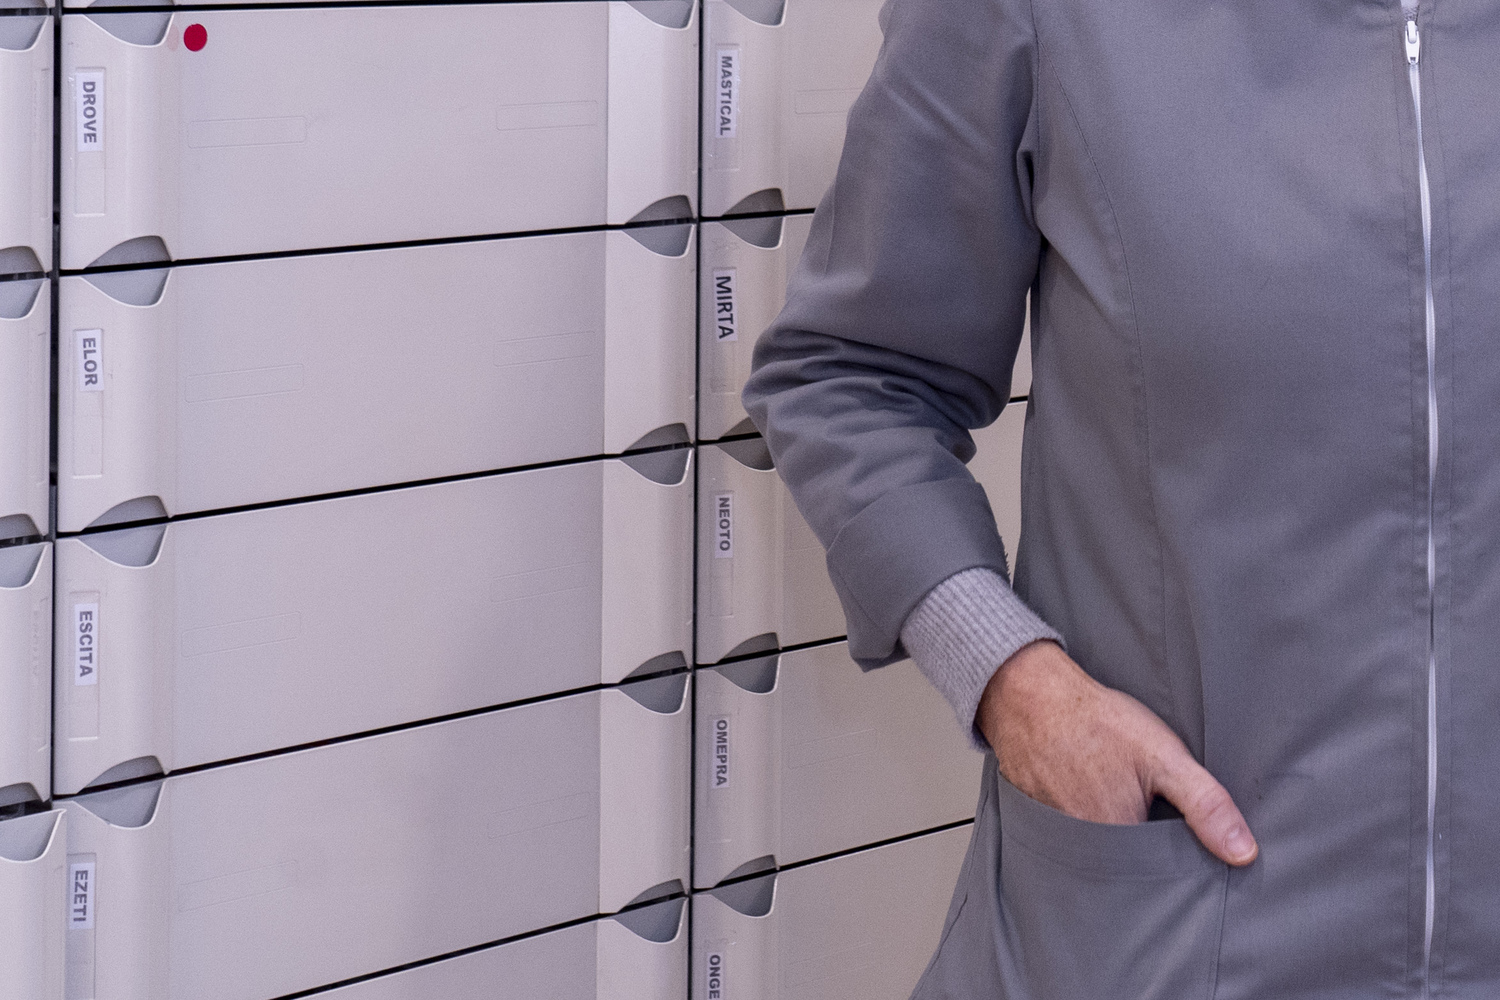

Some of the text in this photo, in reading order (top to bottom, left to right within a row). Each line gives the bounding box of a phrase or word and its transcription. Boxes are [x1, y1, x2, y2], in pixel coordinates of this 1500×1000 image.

[82, 81, 97, 144] DROVE
[720, 56, 733, 136] MASTICAL
[716, 276, 734, 339] MIRTA
[83, 338, 98, 386] ELOR
[719, 497, 731, 551] NEOTO
[79, 611, 93, 677] ESCITA
[716, 719, 728, 786] OMEPRA
[73, 870, 88, 921] EZETI
[709, 955, 721, 999] ONGE
